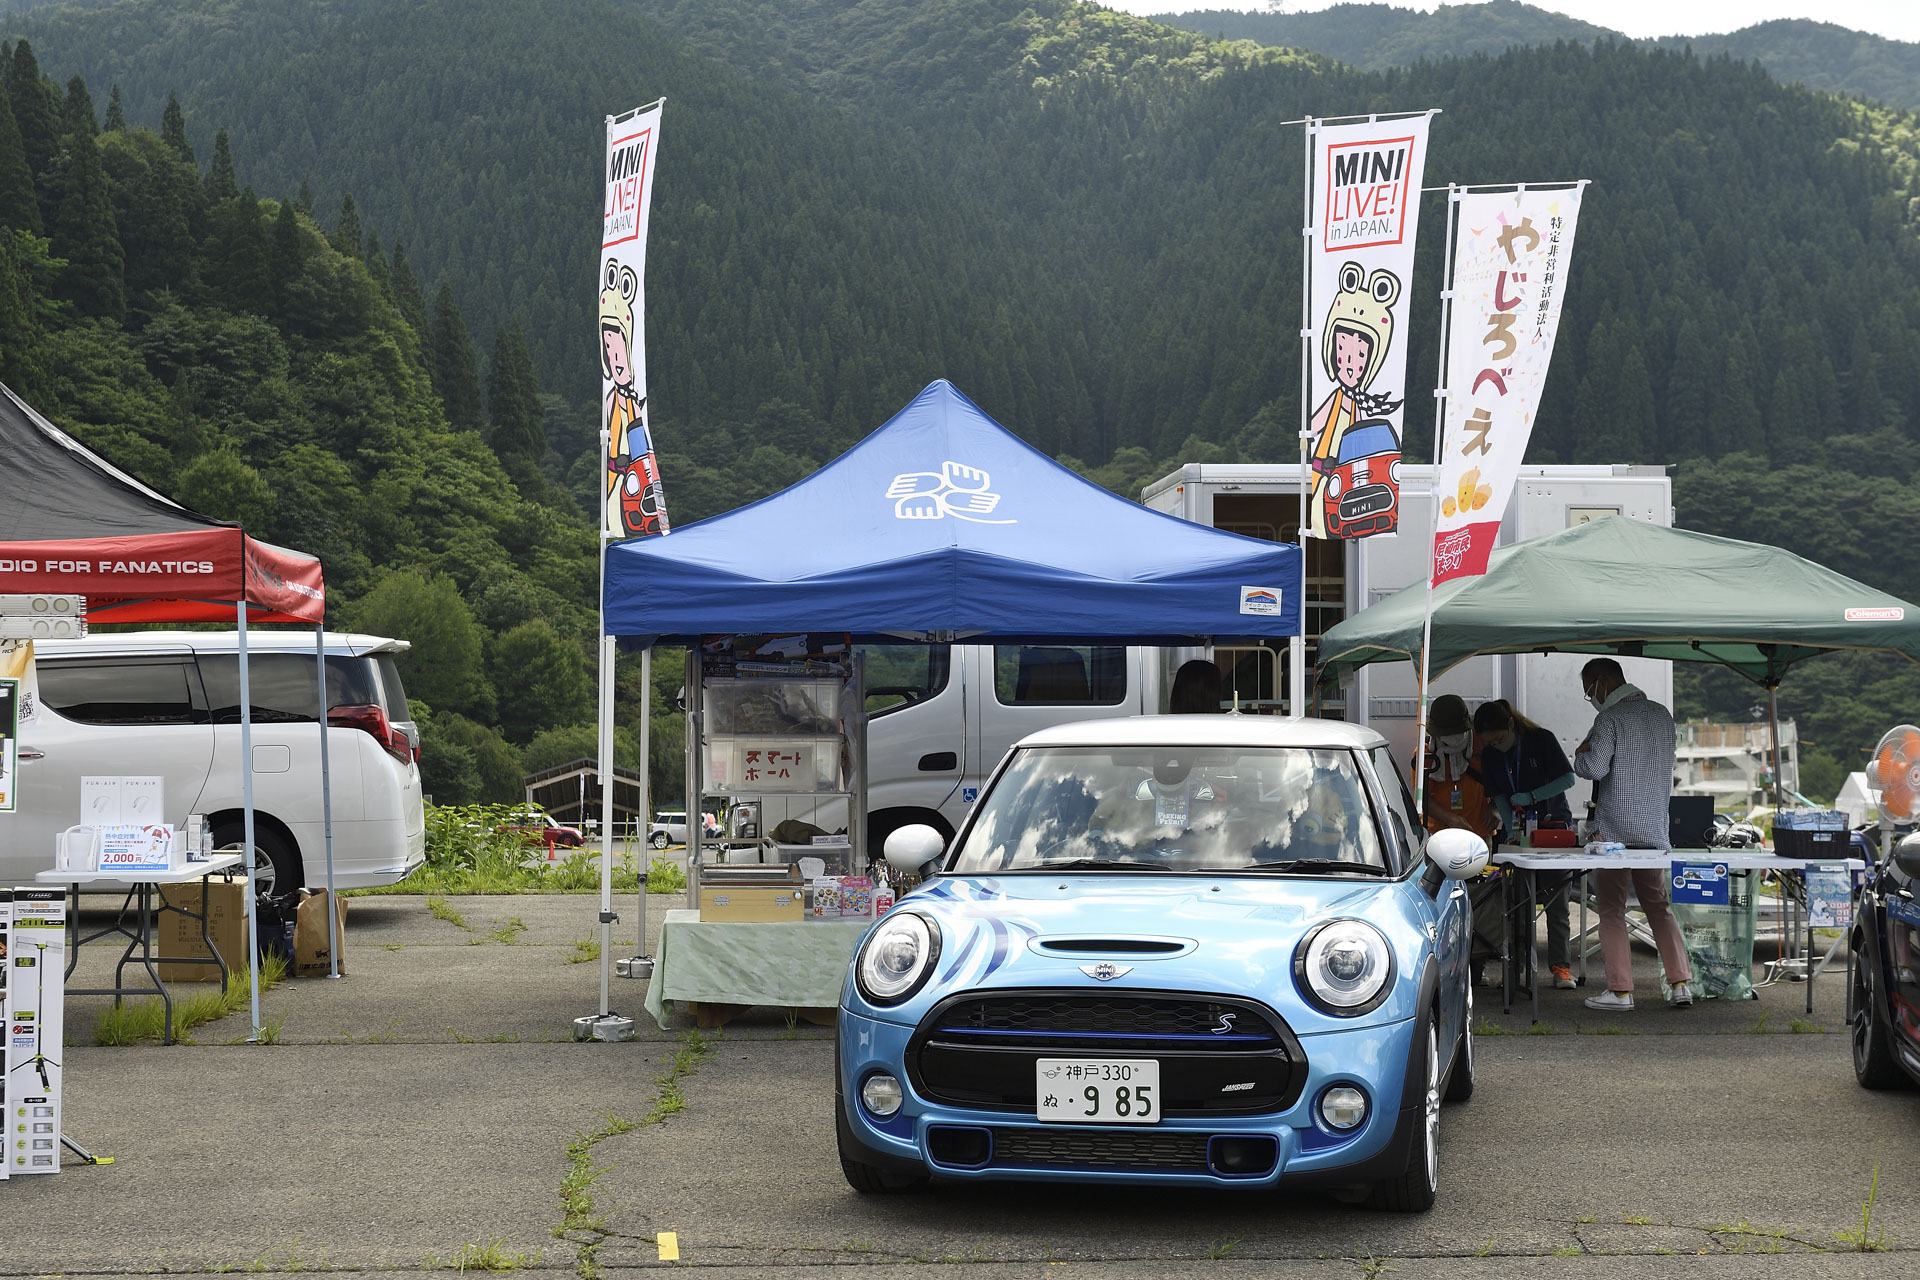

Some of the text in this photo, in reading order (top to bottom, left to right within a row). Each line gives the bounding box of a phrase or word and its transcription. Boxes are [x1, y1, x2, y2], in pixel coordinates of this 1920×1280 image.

[608, 141, 644, 183] MINI
[1335, 149, 1405, 188] MINI
[1333, 183, 1399, 222] LIVE!
[608, 213, 634, 236] JAPAN.
[1331, 217, 1393, 240] in JAPAN.
[1534, 216, 1563, 339] 特定非営利活動法人
[1461, 216, 1540, 457] やじろべえ
[1352, 503, 1371, 516] MINI
[46, 560, 91, 573] FOR
[99, 561, 214, 574] FANATICS
[1849, 610, 1890, 618] Coleman
[1158, 812, 1187, 820] PARKING
[1211, 1013, 1236, 1035] S
[1043, 1093, 1058, 1108] ぬ
